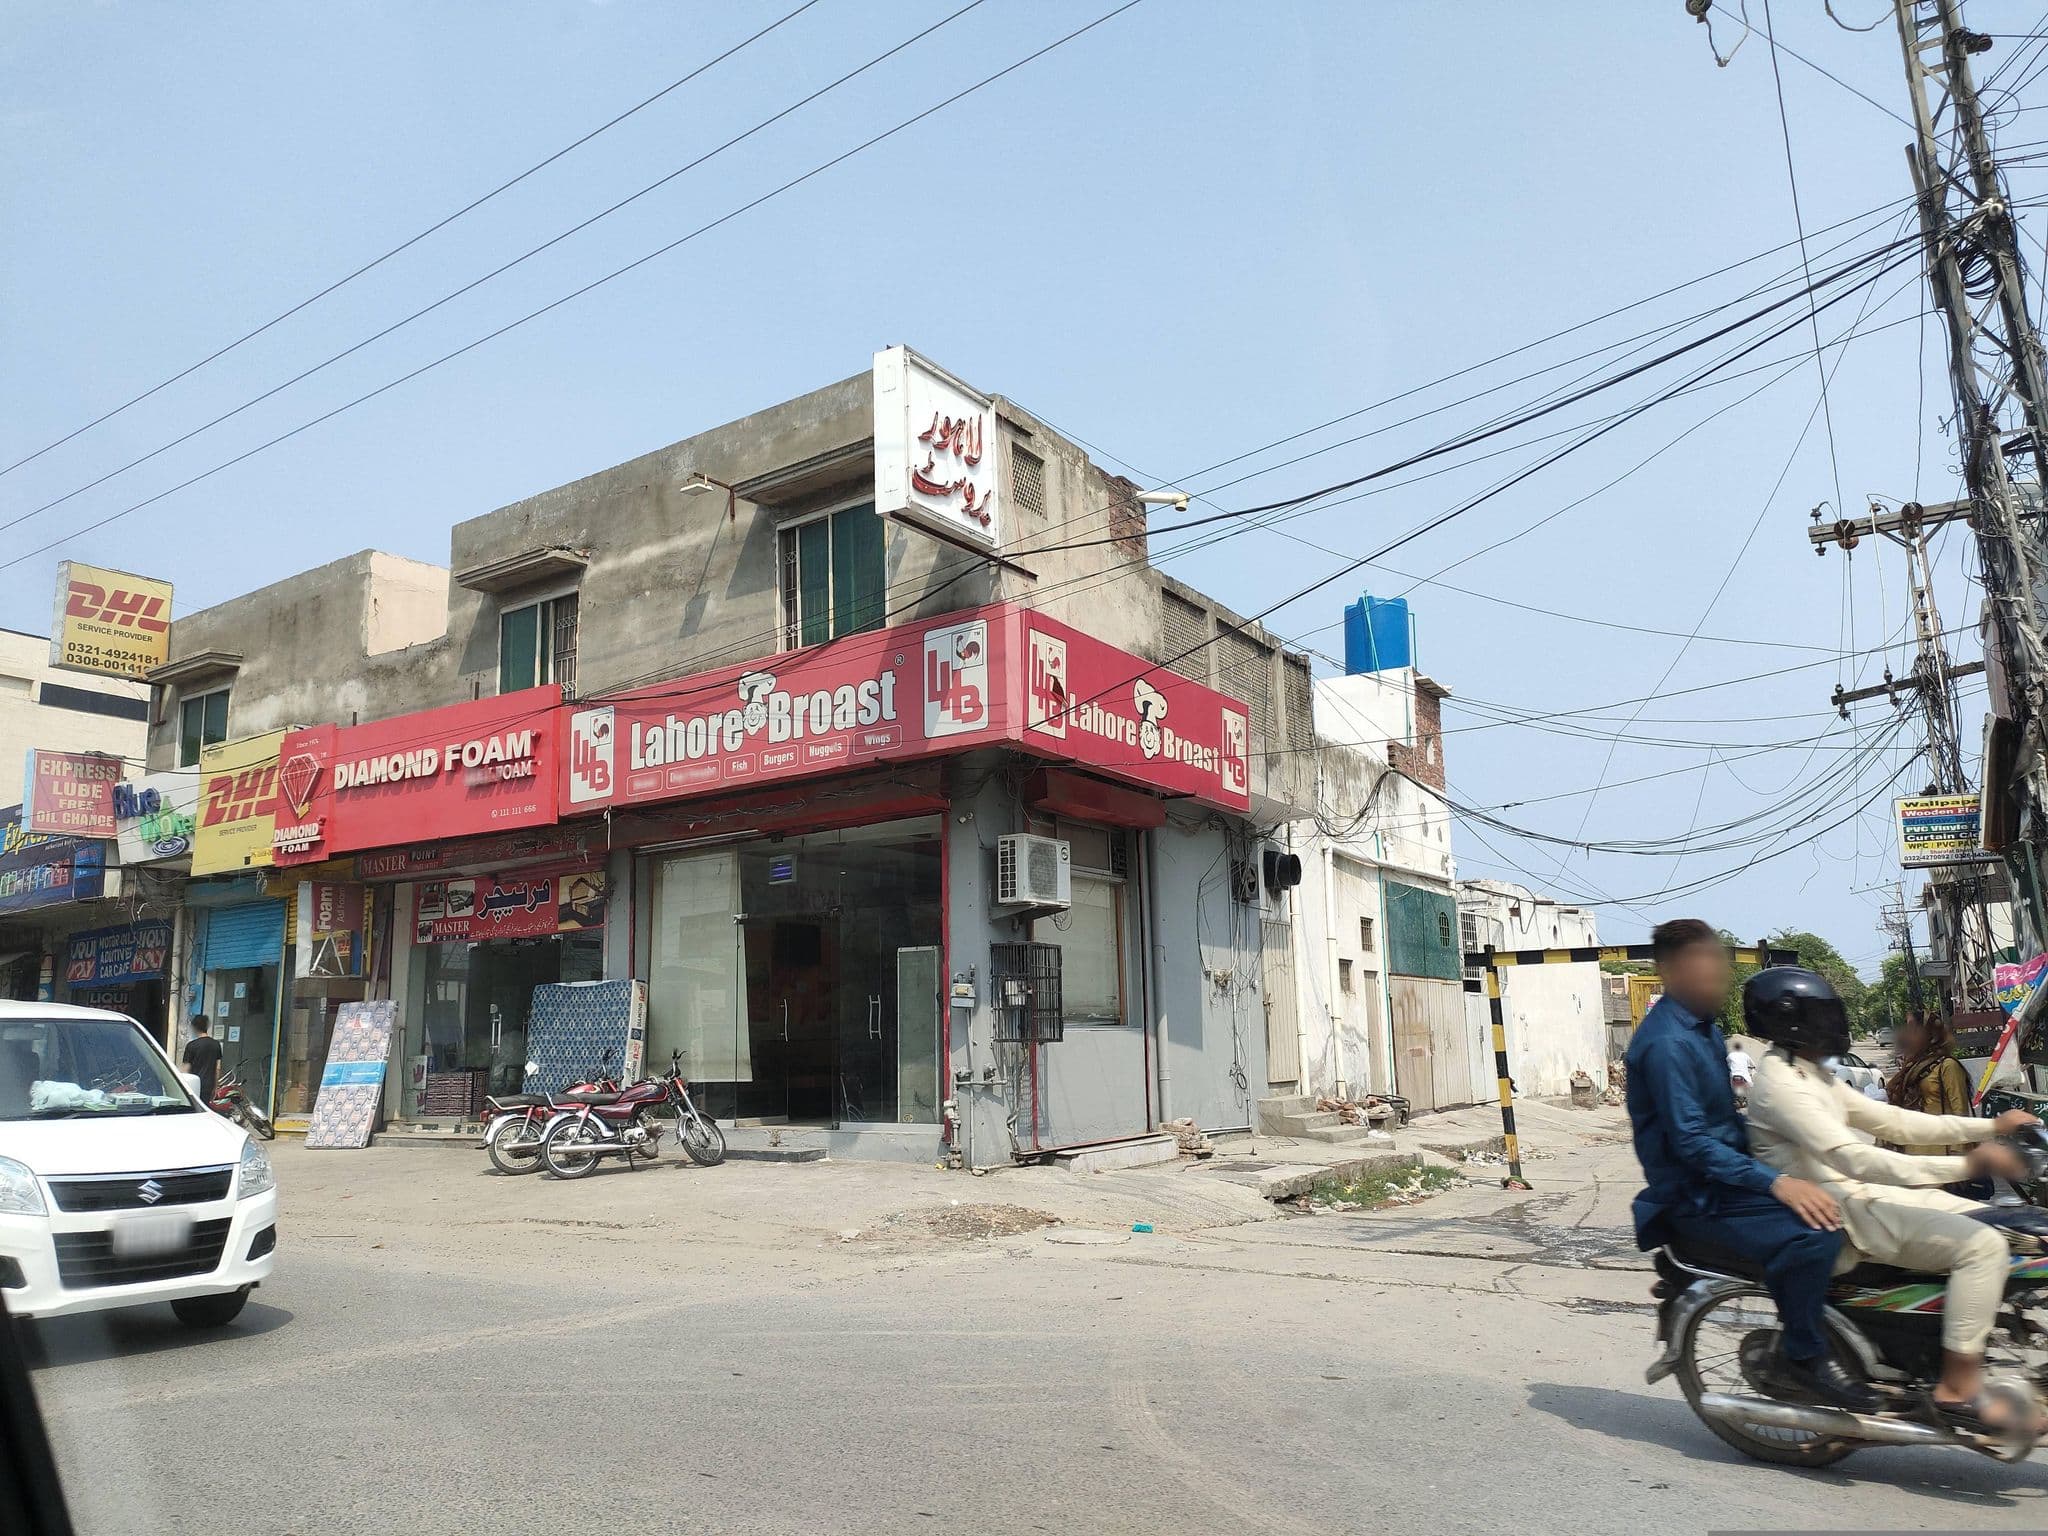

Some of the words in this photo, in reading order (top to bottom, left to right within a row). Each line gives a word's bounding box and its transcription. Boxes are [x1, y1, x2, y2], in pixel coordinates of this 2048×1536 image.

[65, 580, 169, 633] DHL
[77, 622, 113, 636] SERVICE
[113, 629, 153, 642] PROVIDER
[68, 641, 159, 666] 0321-4924181
[629, 708, 744, 771] Lahore
[767, 670, 898, 744] Broast
[1069, 693, 1137, 747] Lahore
[1163, 726, 1220, 775] Broast
[333, 749, 439, 790] DIAMOND
[444, 729, 532, 771] FOAM
[731, 761, 748, 771] Fish
[763, 751, 794, 765] Burgers
[40, 759, 117, 782] EXPRESS
[52, 781, 103, 799] LUBE
[203, 766, 280, 827] DHL
[59, 799, 95, 811] FREE
[112, 783, 161, 820] Blue
[36, 810, 58, 823] OIL
[62, 812, 115, 827] CHANGE
[1905, 808, 1954, 817] Wooden
[274, 822, 319, 841] DIAMOND
[1906, 825, 1929, 833] PVC
[1906, 833, 1955, 842] Curtain
[281, 842, 310, 854] FOAM
[1936, 840, 1956, 848] PVC
[360, 854, 406, 875] MASTER
[318, 886, 334, 931] Foam
[433, 920, 470, 935] MASTER
